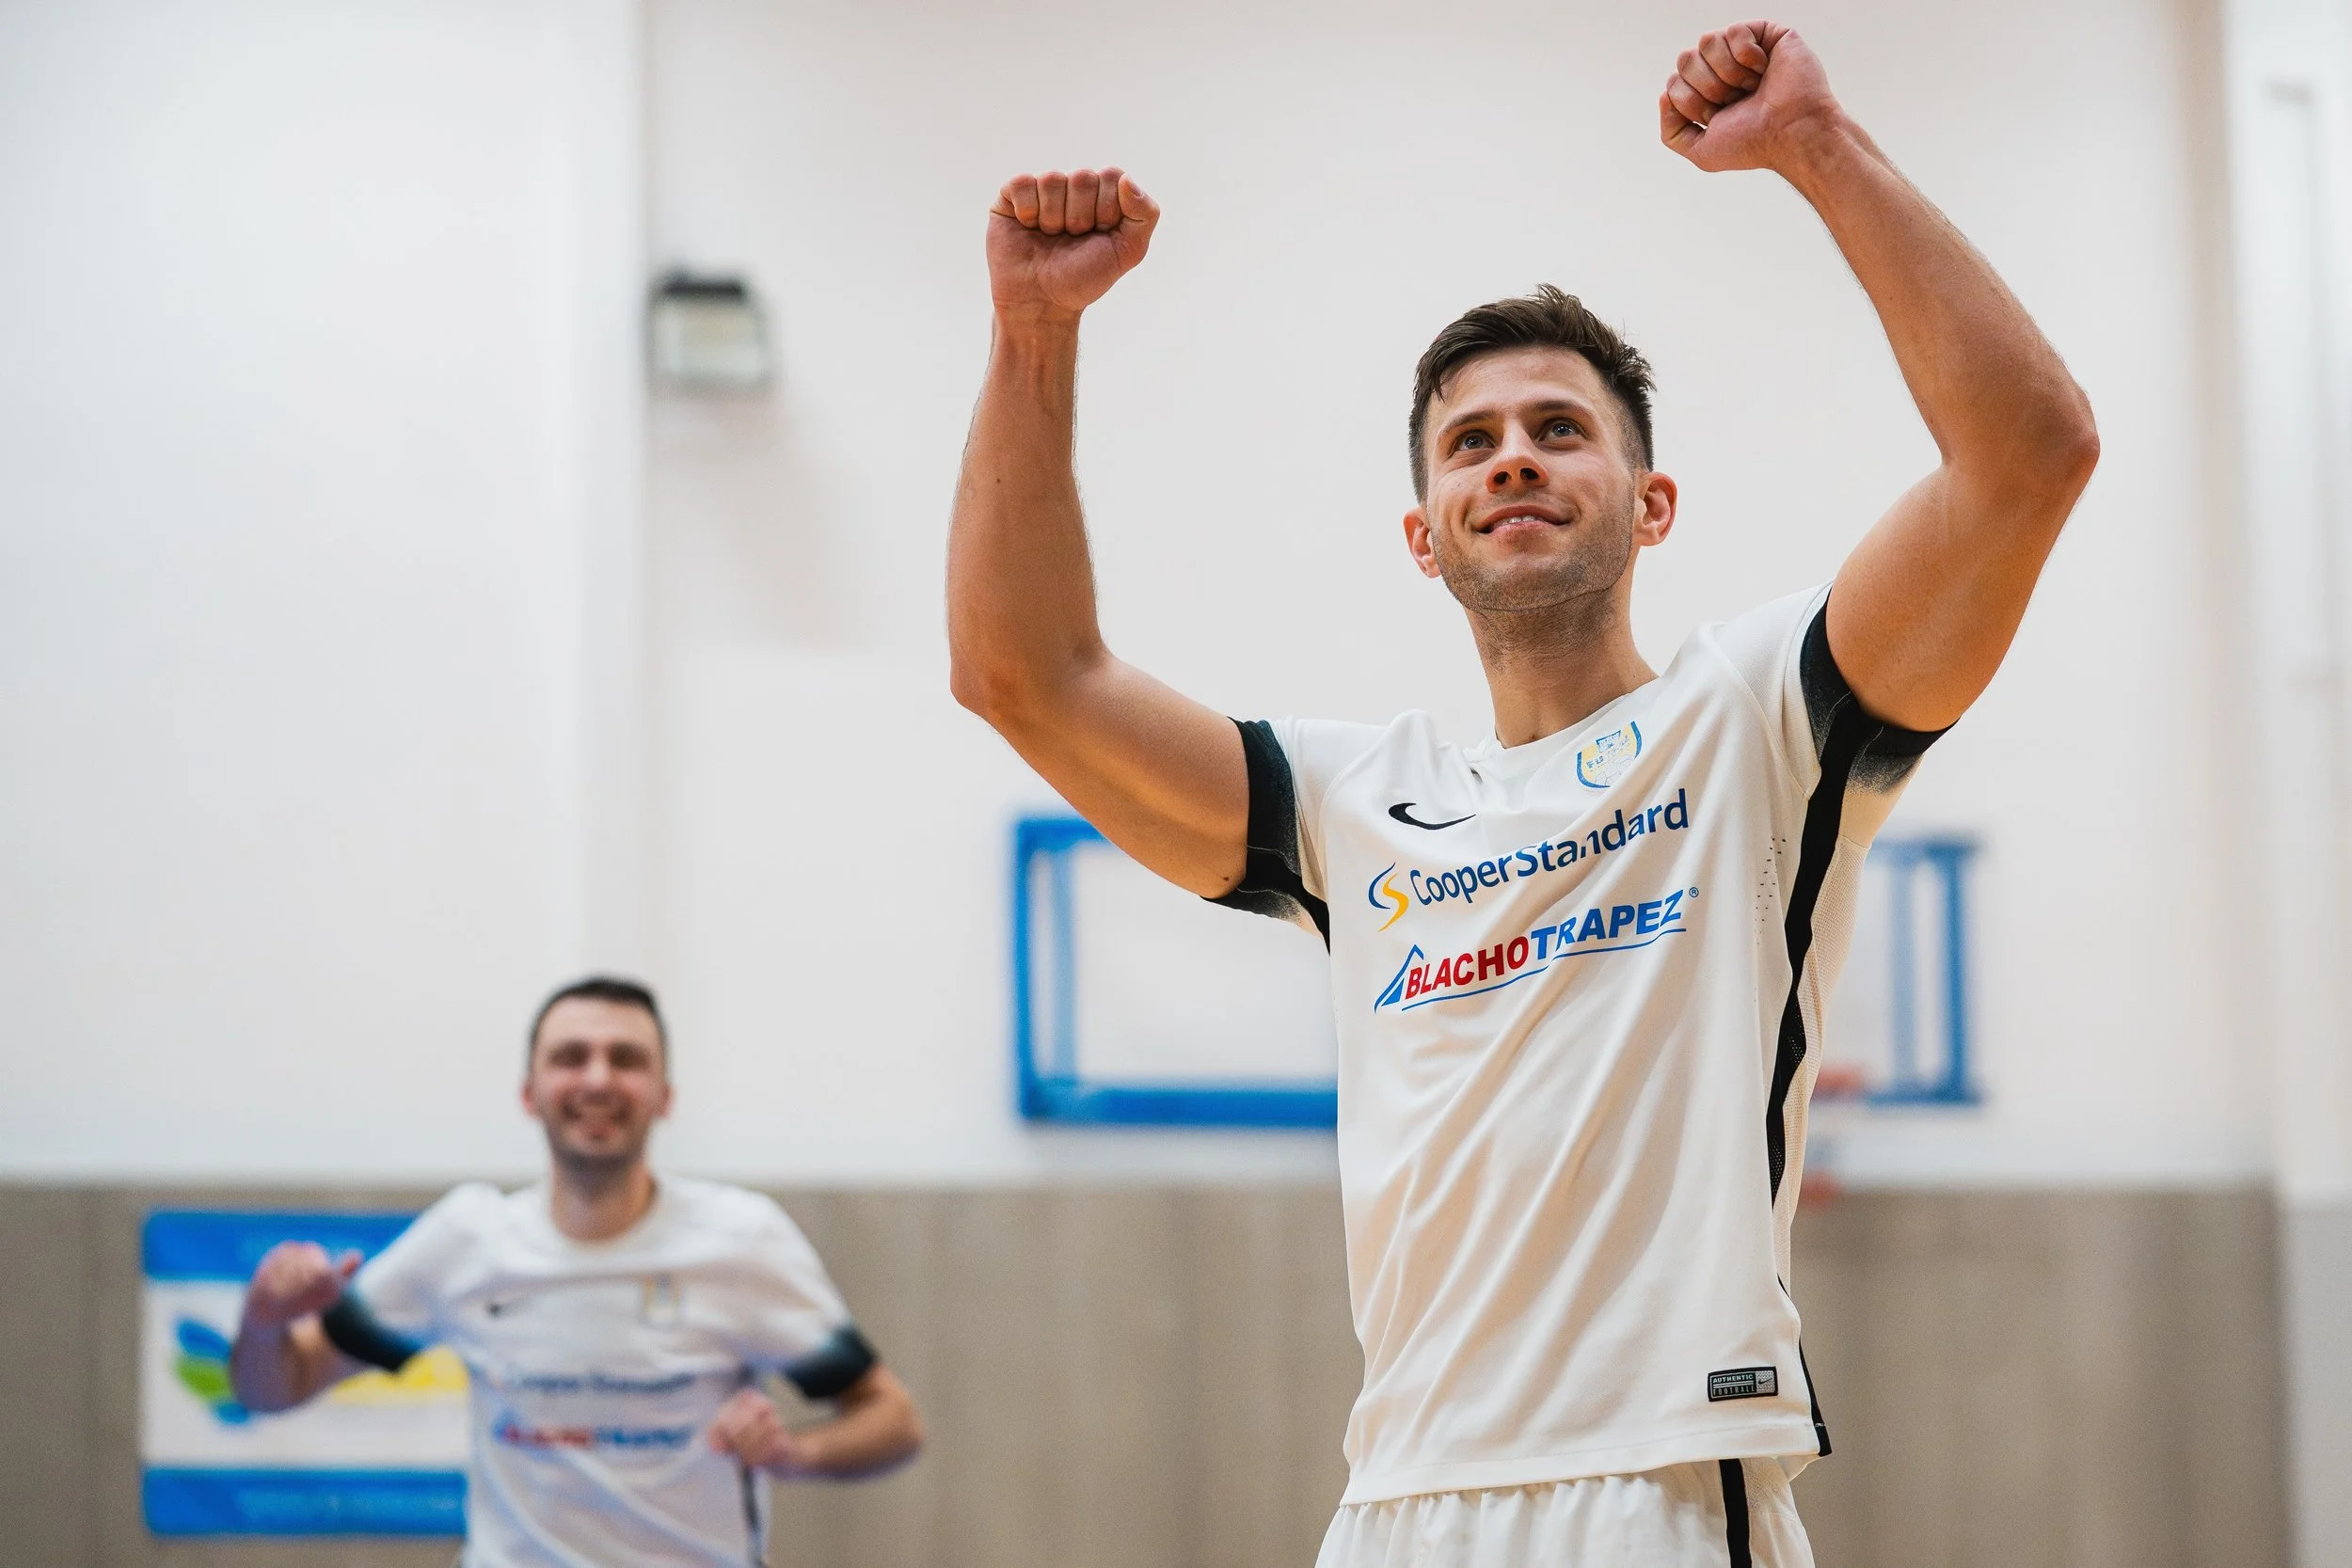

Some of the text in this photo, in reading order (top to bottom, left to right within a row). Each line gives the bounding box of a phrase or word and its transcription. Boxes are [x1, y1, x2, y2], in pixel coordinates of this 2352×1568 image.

[1409, 788, 1690, 906] CooperStandard
[1712, 1374, 1754, 1384] AUTHENTIC
[1712, 1385, 1756, 1396] FOOTBALL
